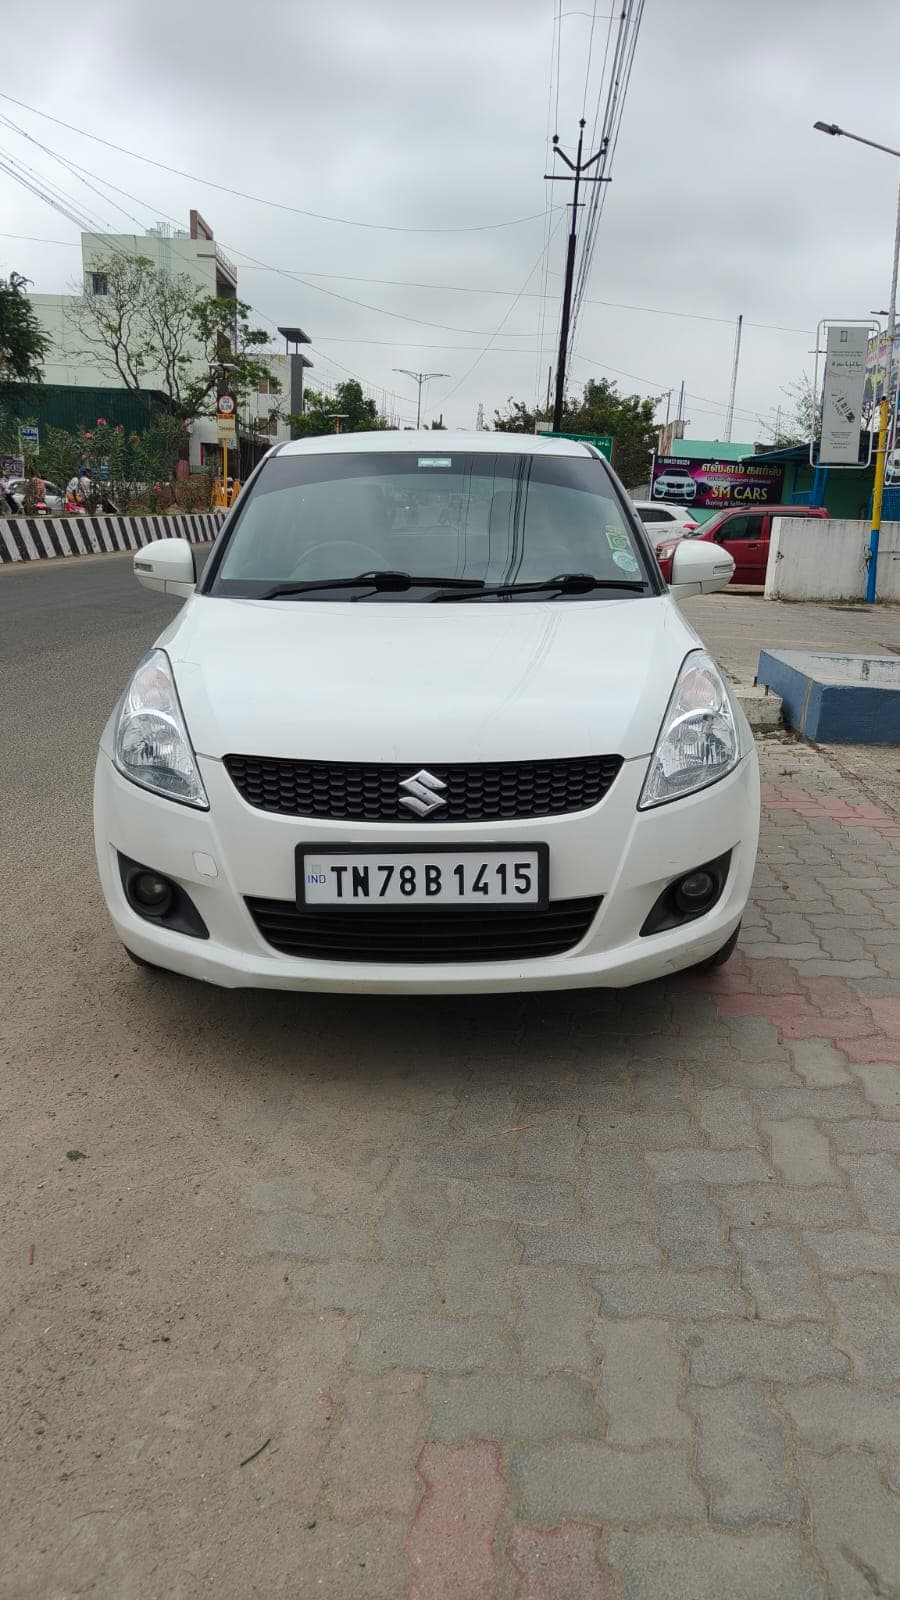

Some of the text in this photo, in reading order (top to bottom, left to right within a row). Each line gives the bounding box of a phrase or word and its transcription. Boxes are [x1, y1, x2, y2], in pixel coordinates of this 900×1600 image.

[712, 485, 768, 500] SM CARS
[307, 874, 326, 884] IND
